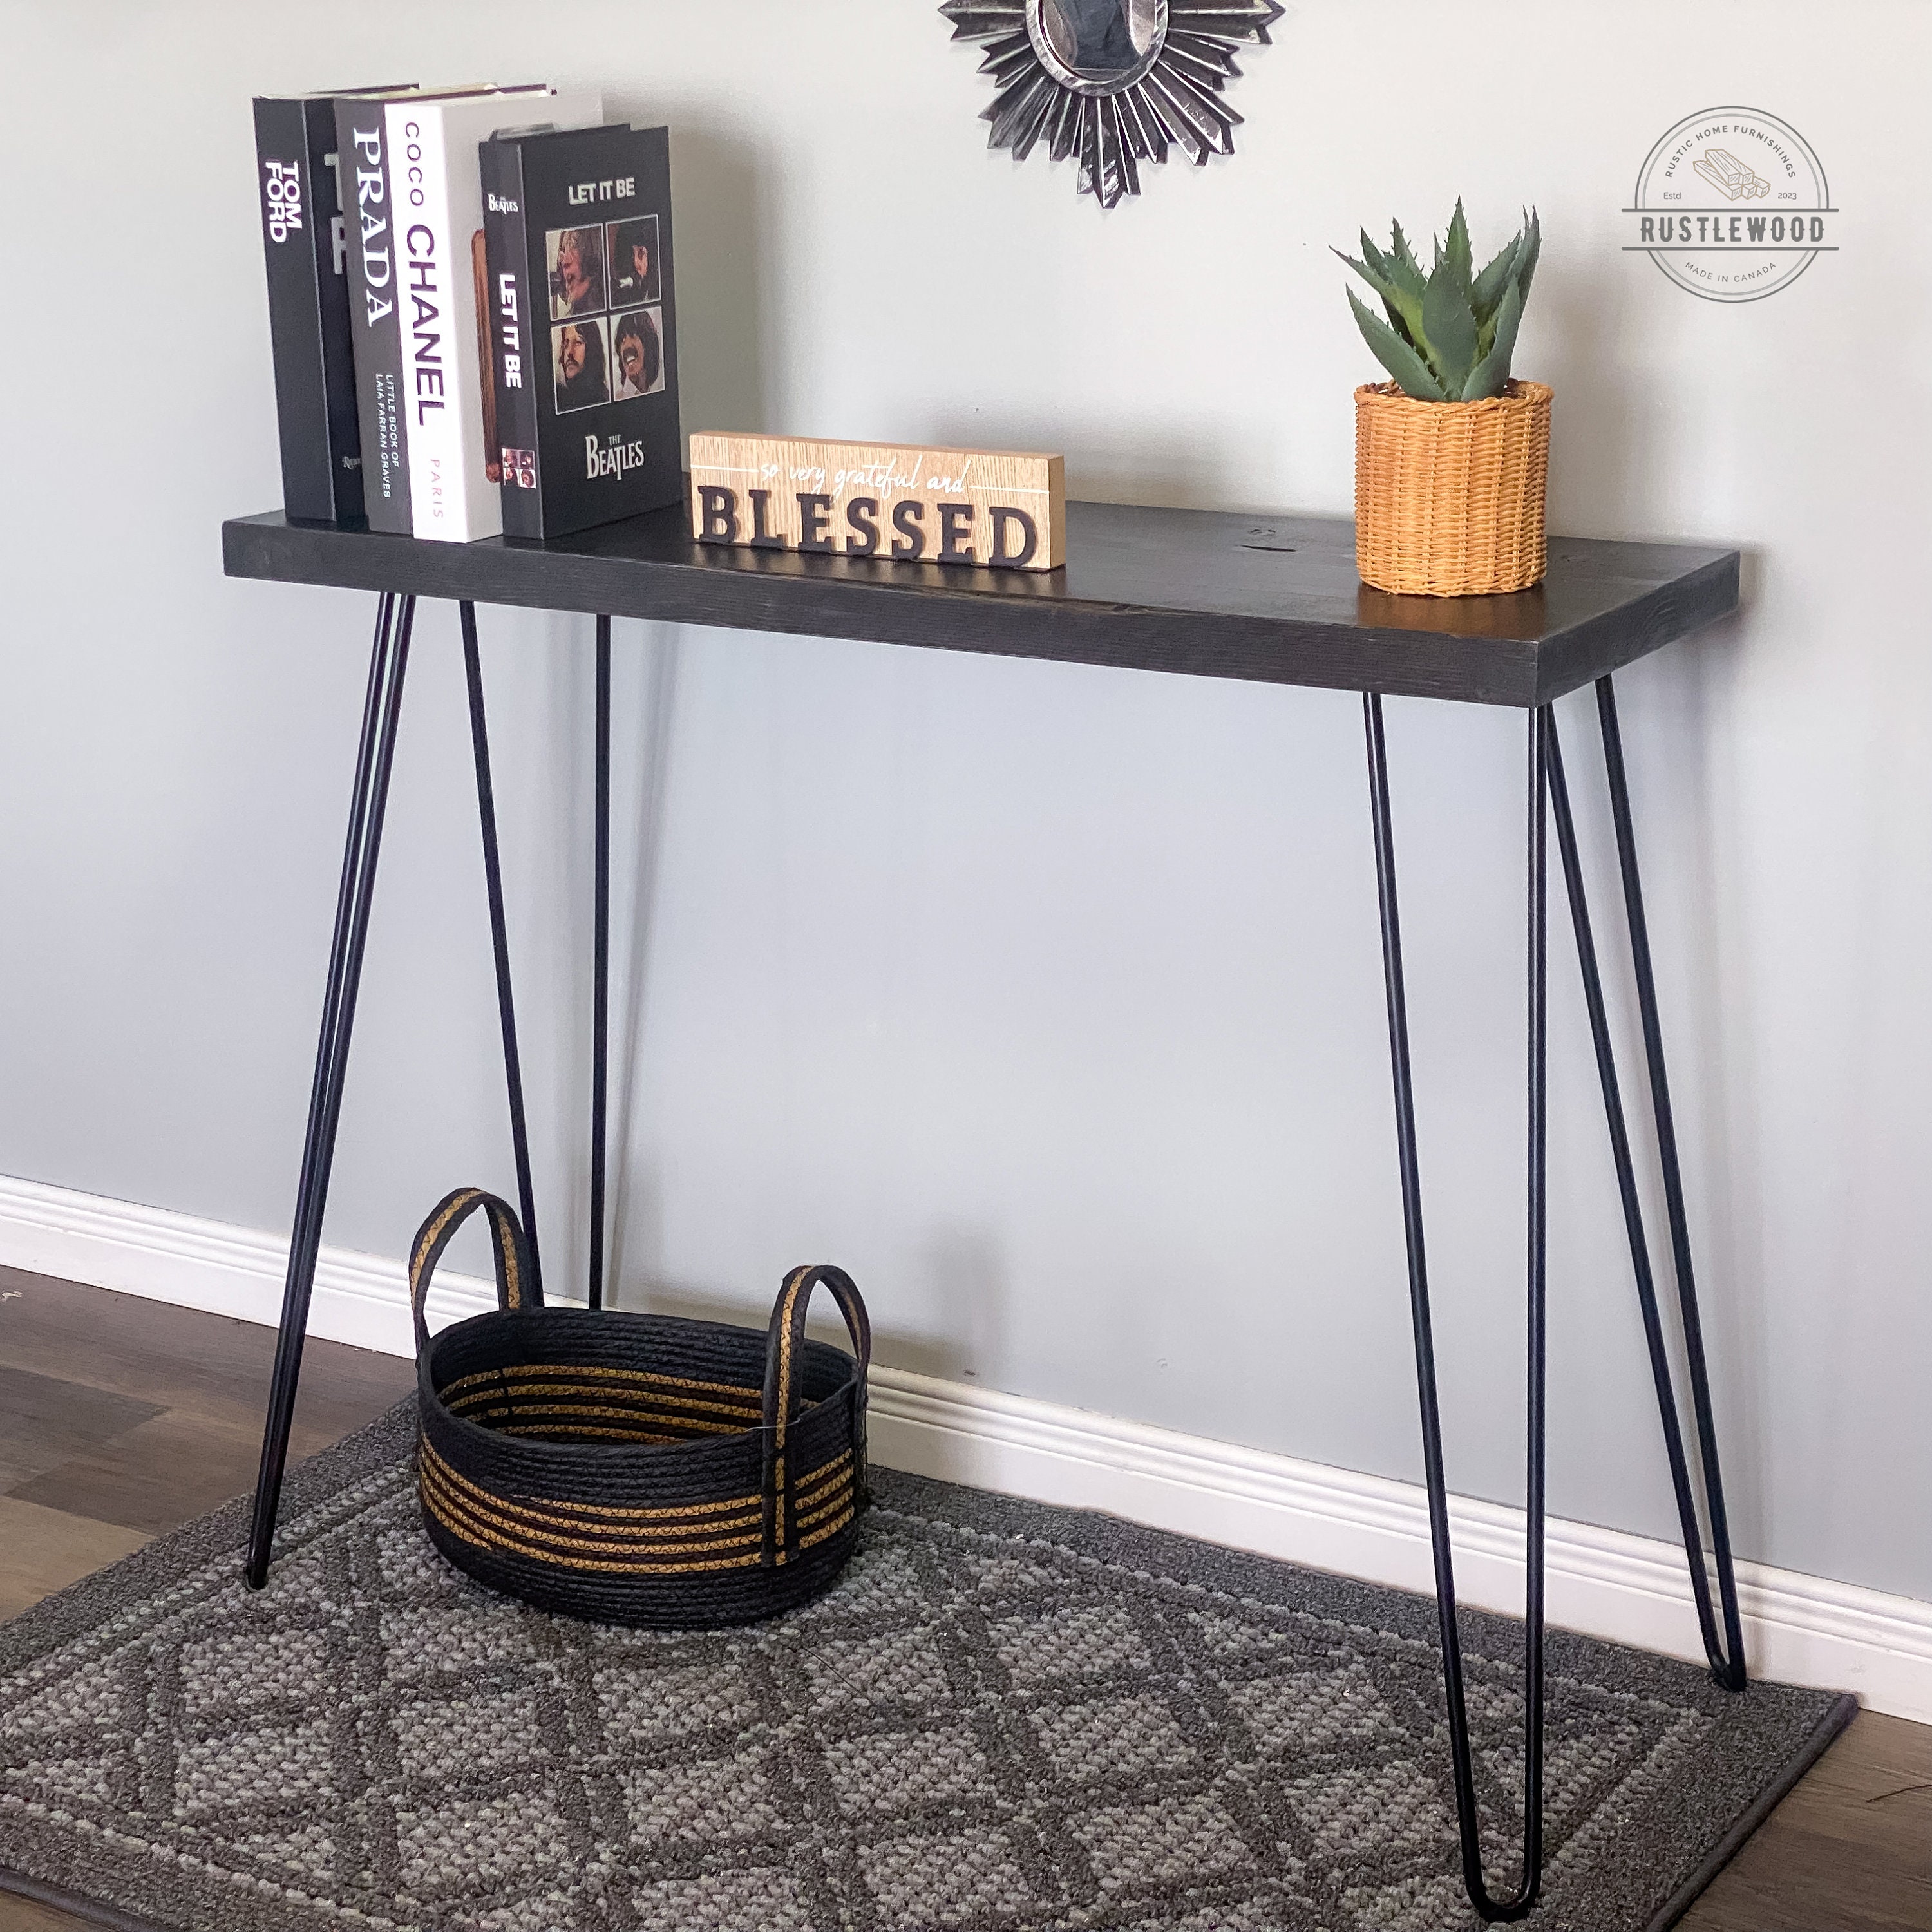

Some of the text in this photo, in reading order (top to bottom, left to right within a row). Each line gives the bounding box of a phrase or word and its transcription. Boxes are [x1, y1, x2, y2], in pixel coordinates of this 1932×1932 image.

[265, 161, 287, 243] FORD
[282, 160, 303, 230] TOM
[354, 126, 393, 328] PRADA
[568, 176, 636, 205] LET IT BE
[405, 121, 445, 426] COCO CHANEL
[499, 274, 522, 388] LET IT BE
[375, 374, 391, 498] LAIA FARRAN GRAVES
[385, 374, 399, 468] LITTLE BOOK OF
[585, 434, 645, 480] BEATLES
[608, 433, 622, 444] THE
[430, 459, 444, 518] PARIS
[760, 455, 972, 500] so very grateful and
[697, 484, 1039, 569] BLESSED
